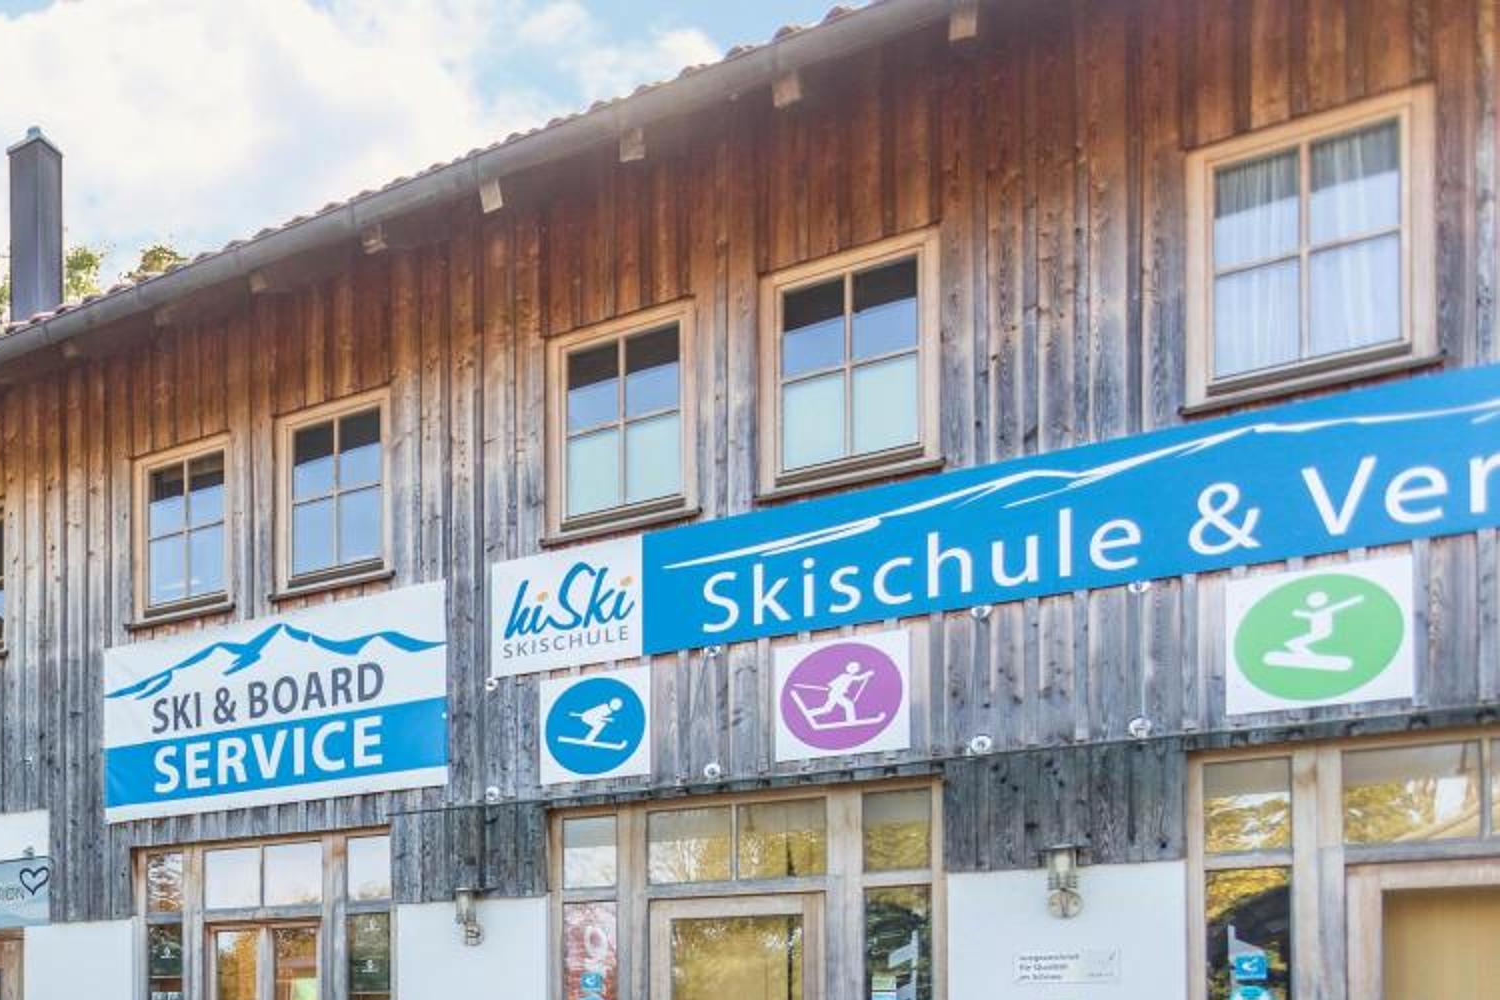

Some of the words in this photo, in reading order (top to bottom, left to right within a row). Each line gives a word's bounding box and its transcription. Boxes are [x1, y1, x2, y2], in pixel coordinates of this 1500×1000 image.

[702, 507, 1141, 633] Skischule
[1188, 482, 1263, 556] &
[1300, 453, 1500, 536] Ver
[502, 625, 629, 659] SKISCHULE
[151, 691, 203, 734] SKI
[212, 687, 238, 725] &
[248, 662, 385, 719] BOARD
[153, 715, 384, 794] SERVICE
